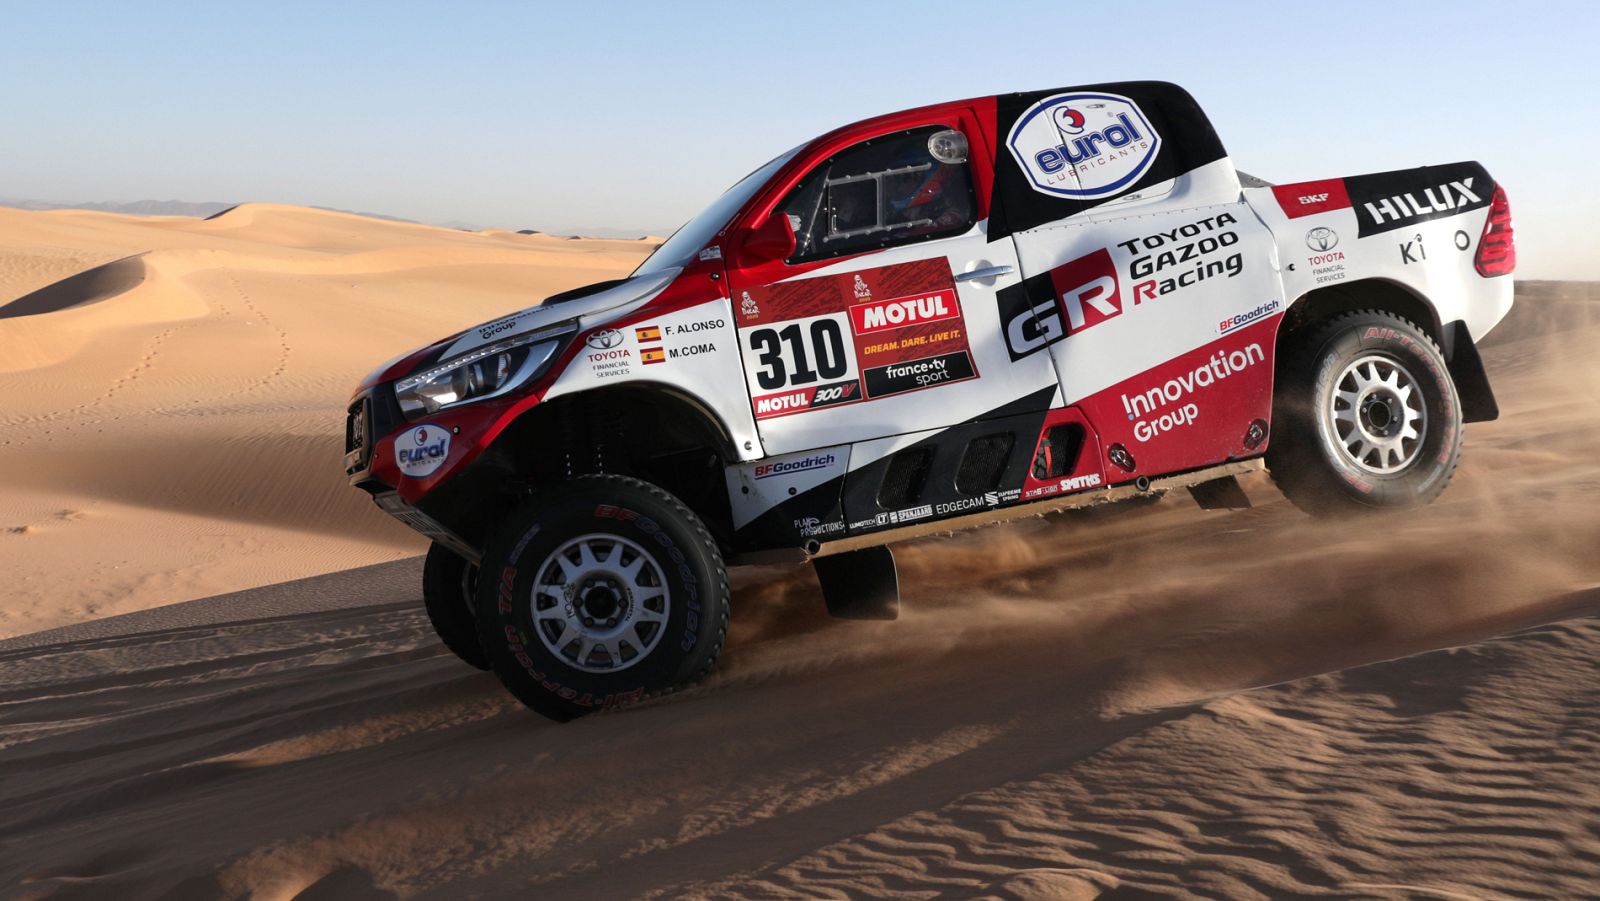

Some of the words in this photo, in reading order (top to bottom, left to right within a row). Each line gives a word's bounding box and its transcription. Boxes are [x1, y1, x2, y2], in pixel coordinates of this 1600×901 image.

[1034, 111, 1143, 175] eurol
[1047, 141, 1149, 185] LUBRICANTS
[1298, 192, 1329, 205] SKF
[1117, 212, 1238, 255] TOYOTA
[1129, 231, 1239, 280] GAZOO
[1308, 252, 1345, 266] TOYOTA
[1133, 252, 1243, 306] Racing
[1312, 264, 1345, 276] FINANCIAL
[1316, 273, 1345, 284] SERVICES
[863, 295, 948, 329] MOTUL
[1007, 275, 1119, 354] GR
[1219, 300, 1279, 332] BFGoodrich
[482, 321, 516, 339] Group
[665, 325, 676, 336] F.
[678, 319, 725, 334] ALONSO
[749, 318, 848, 391] 310
[864, 343, 899, 355] DREAM.
[901, 337, 928, 348] DARE.
[929, 332, 949, 343] LIVE
[950, 329, 961, 340] IT.
[587, 349, 631, 363] TOYOTA
[593, 360, 630, 371] FINANCIAL
[596, 368, 630, 379] SERVICES
[915, 367, 950, 386] sport
[1121, 342, 1265, 421] Innovation
[757, 392, 809, 414] MOTUL
[813, 382, 857, 403] 300V
[1133, 402, 1199, 442] Group
[399, 438, 446, 464] eurol
[754, 454, 835, 477] BFGoodrich
[936, 496, 984, 514] EDGECAM
